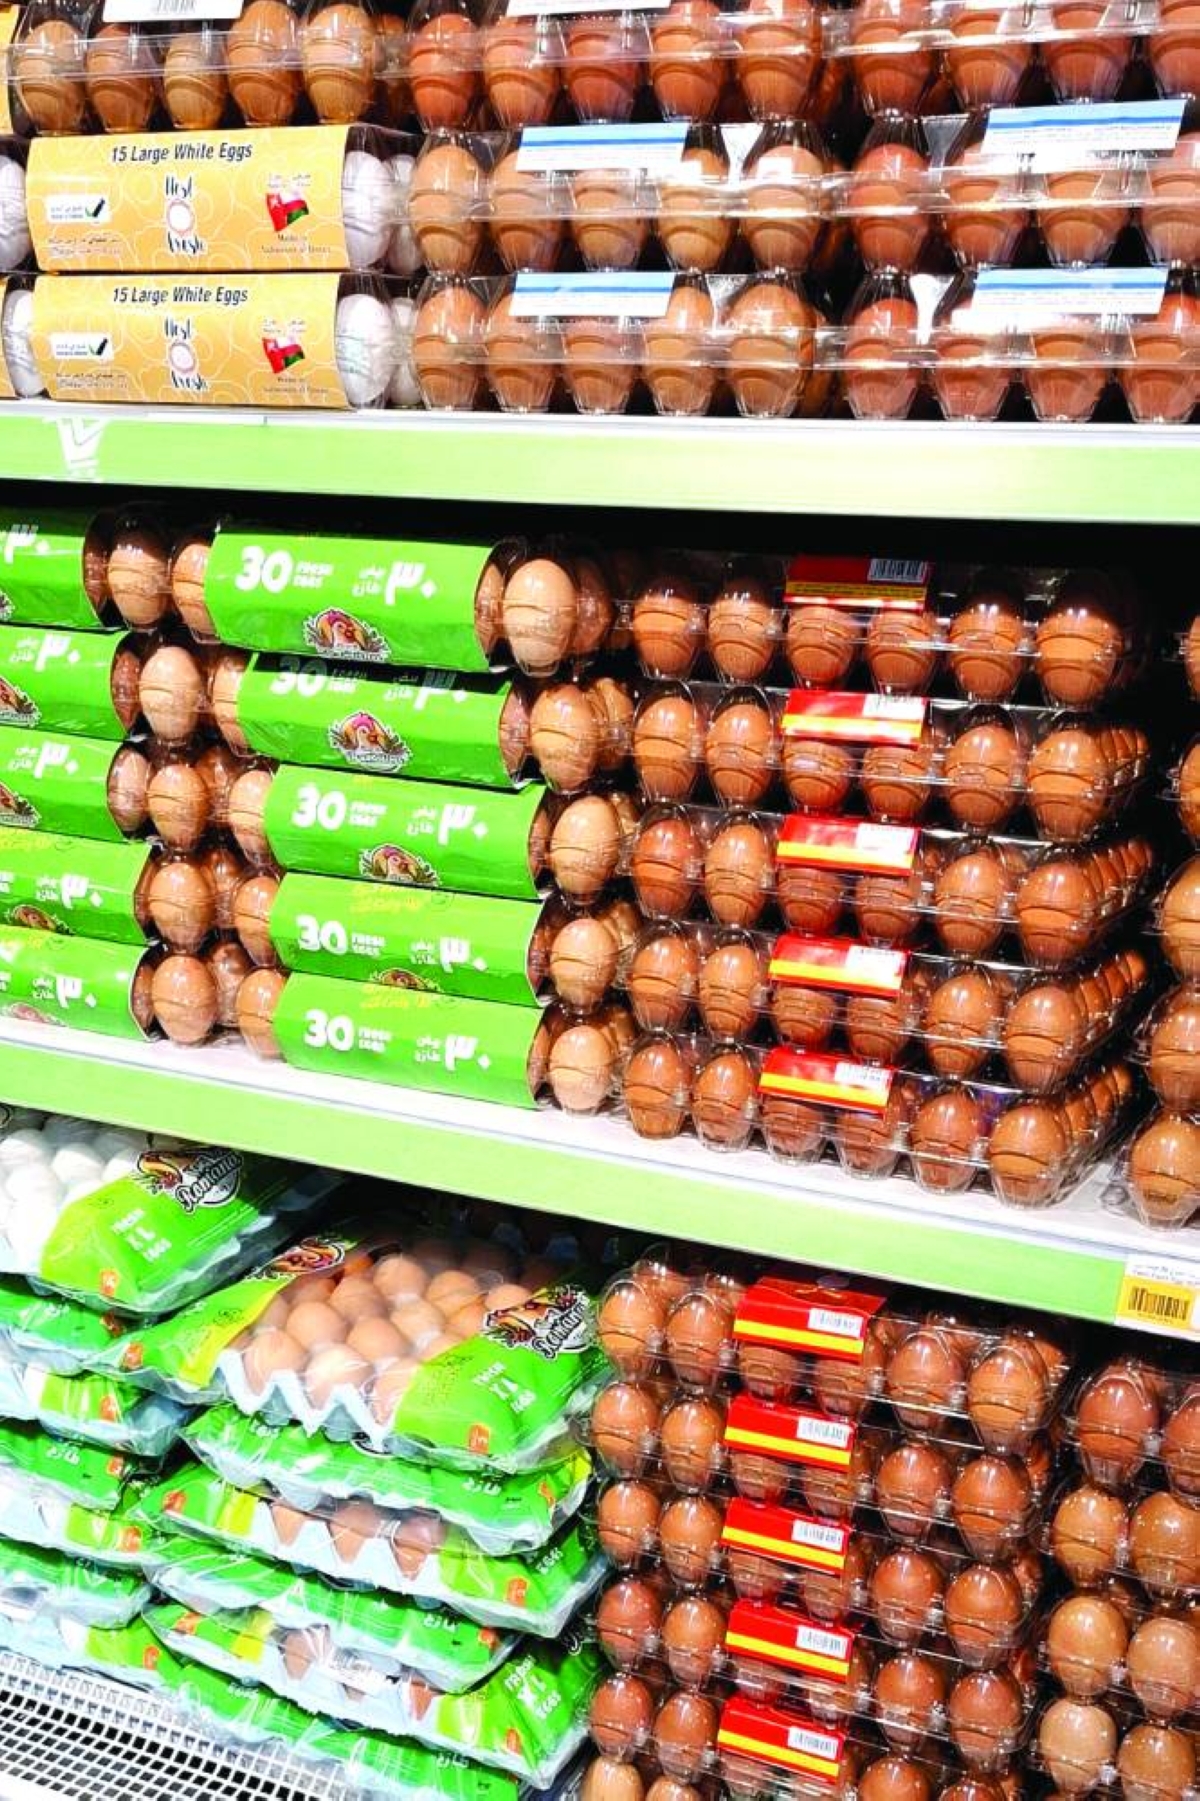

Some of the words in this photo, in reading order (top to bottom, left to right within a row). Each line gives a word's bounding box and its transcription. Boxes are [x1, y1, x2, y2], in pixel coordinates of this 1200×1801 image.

[112, 146, 128, 162] 15
[131, 146, 169, 165] Large
[174, 143, 214, 161] White
[219, 142, 253, 162] Eggs
[113, 286, 128, 302] 15
[131, 286, 169, 306] Large
[173, 286, 213, 302] White
[215, 286, 248, 306] Eggs
[235, 545, 293, 594] 30
[270, 656, 327, 697] 30
[292, 782, 347, 831] 30
[296, 914, 347, 956] 30
[303, 1009, 355, 1052] 30
